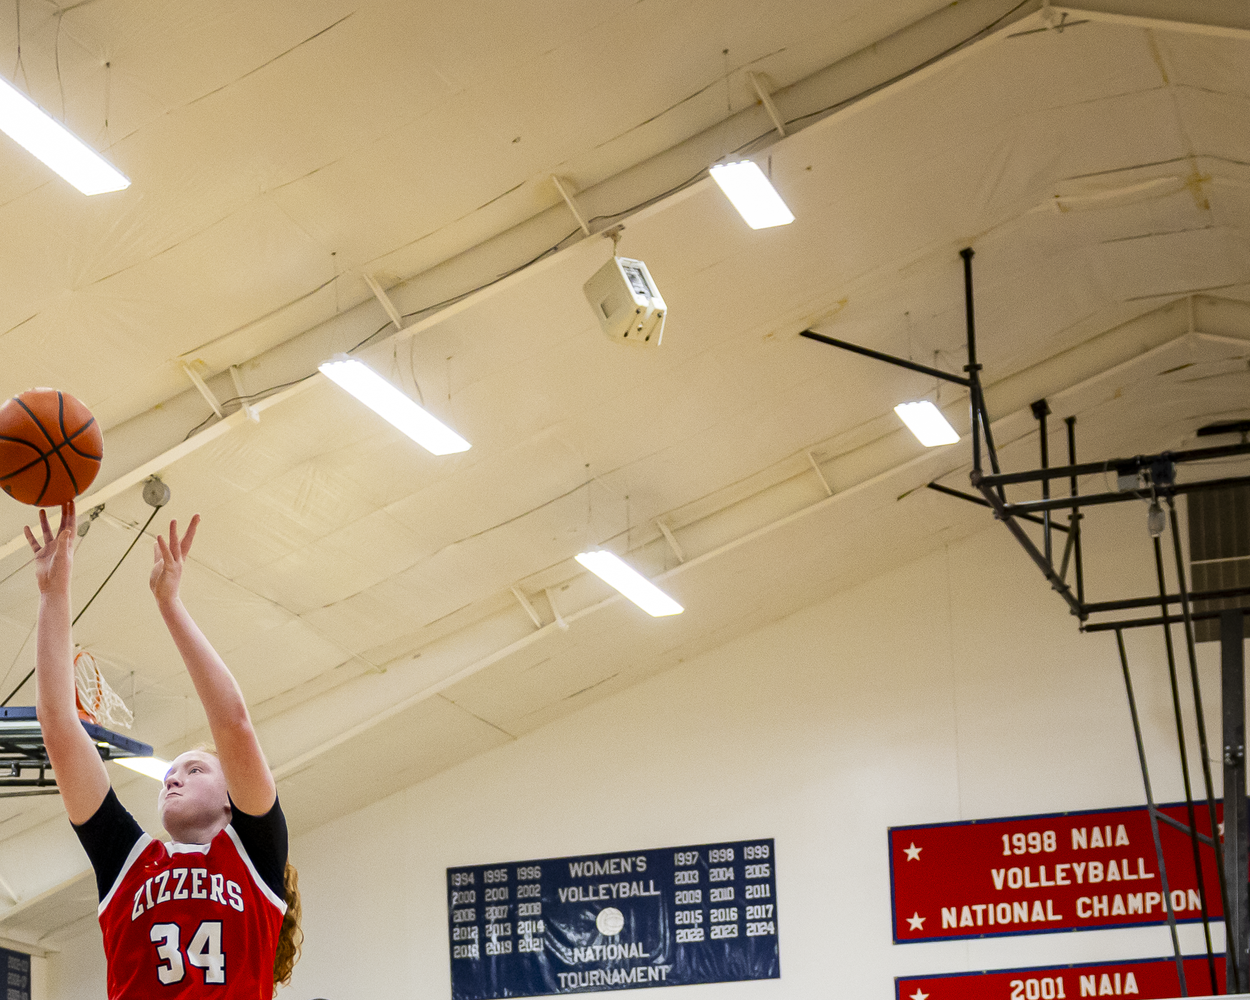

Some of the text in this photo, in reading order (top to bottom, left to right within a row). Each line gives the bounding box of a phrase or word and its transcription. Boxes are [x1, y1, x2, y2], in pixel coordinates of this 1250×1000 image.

[1001, 824, 1130, 856] 1998 NAIA
[674, 845, 769, 866] 1997 1998 1999
[484, 868, 508, 884] 1995
[517, 866, 541, 880] 1996
[569, 856, 647, 878] WOMEN'S
[709, 867, 734, 882] 2004
[745, 863, 770, 879] 2005
[991, 857, 1154, 890] VOLLEYBALL
[131, 867, 245, 922] ZIZZERS
[452, 884, 541, 905] 2000 2001 2002
[558, 880, 661, 903] VOLLEYBALL
[675, 889, 702, 905] 2009
[745, 884, 770, 899] 2011
[675, 904, 773, 925] 2015 2016 2017
[941, 900, 1063, 929] NATIONAL
[485, 922, 511, 938] 2013
[517, 920, 545, 935] 2014
[746, 921, 775, 936] 2024
[150, 920, 227, 986] 34
[573, 942, 650, 963] NATIONAL
[557, 965, 669, 989] TOURNAMENT
[1080, 972, 1139, 997] NAIA
